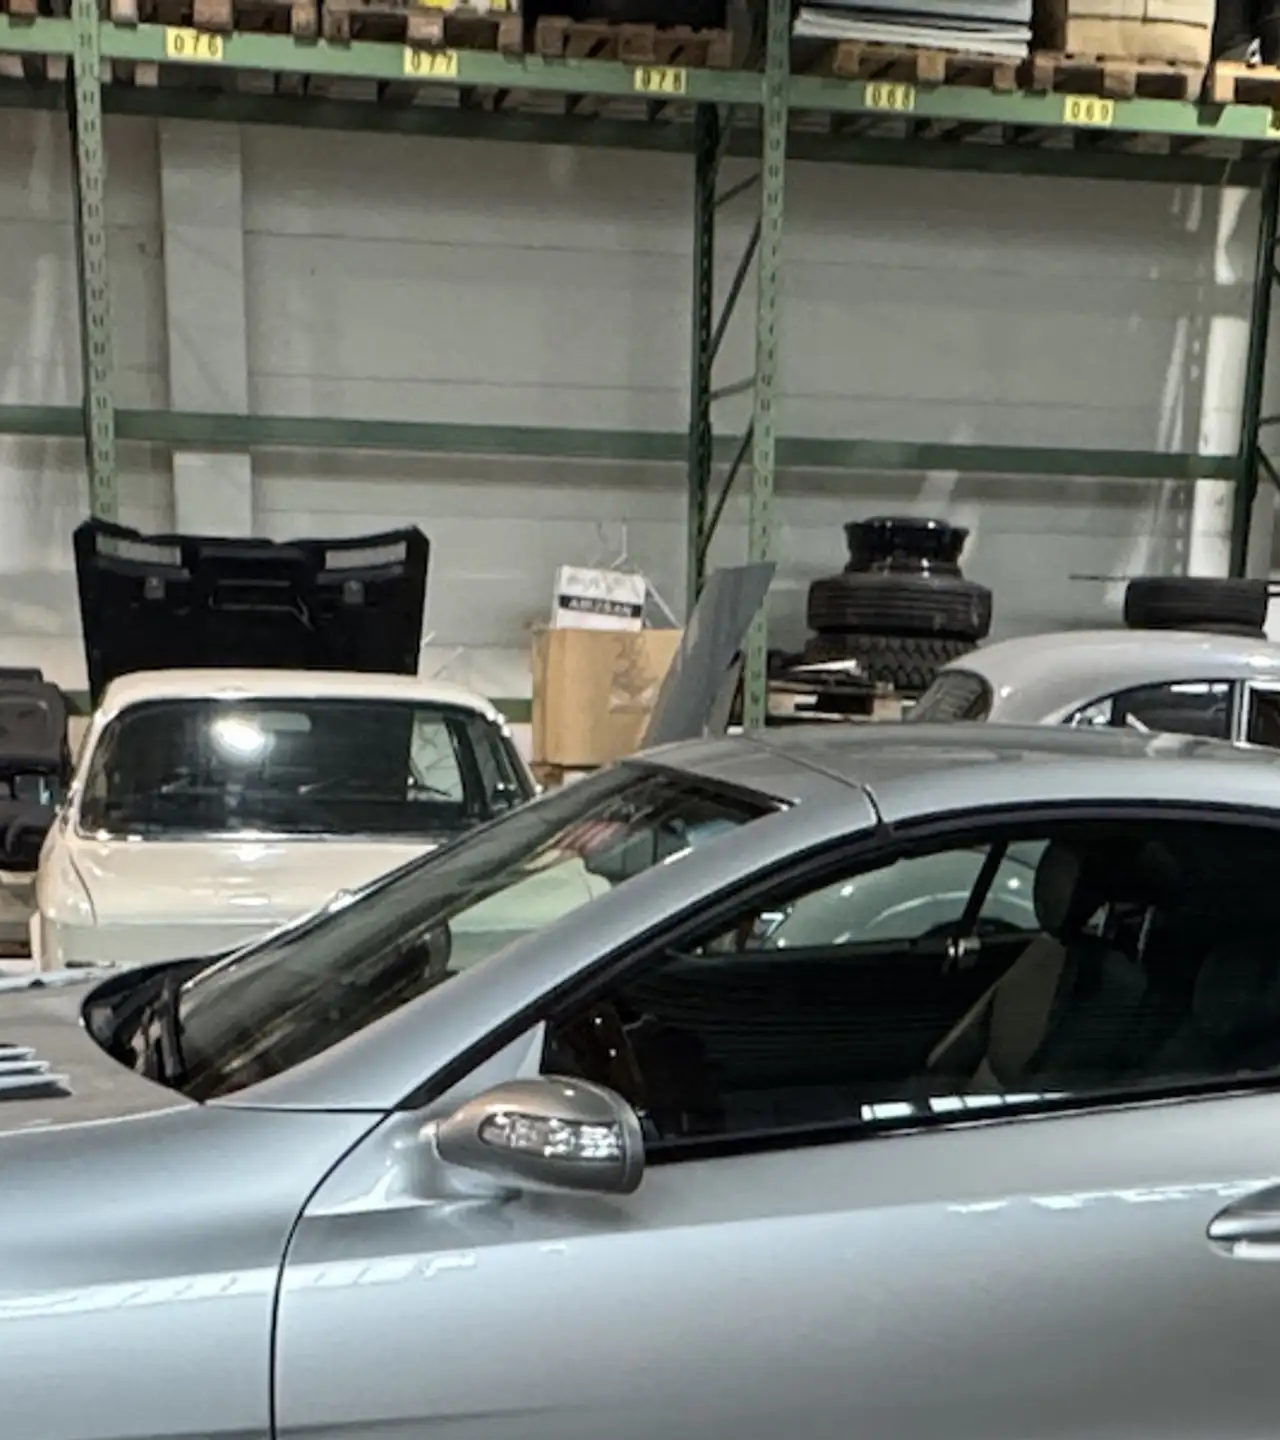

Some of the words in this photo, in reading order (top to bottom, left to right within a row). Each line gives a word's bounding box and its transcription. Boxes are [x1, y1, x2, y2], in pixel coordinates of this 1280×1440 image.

[174, 33, 219, 57] 076
[411, 50, 452, 73] 077
[643, 68, 681, 91] 078
[872, 86, 910, 108] 068
[1071, 101, 1109, 121] 069
